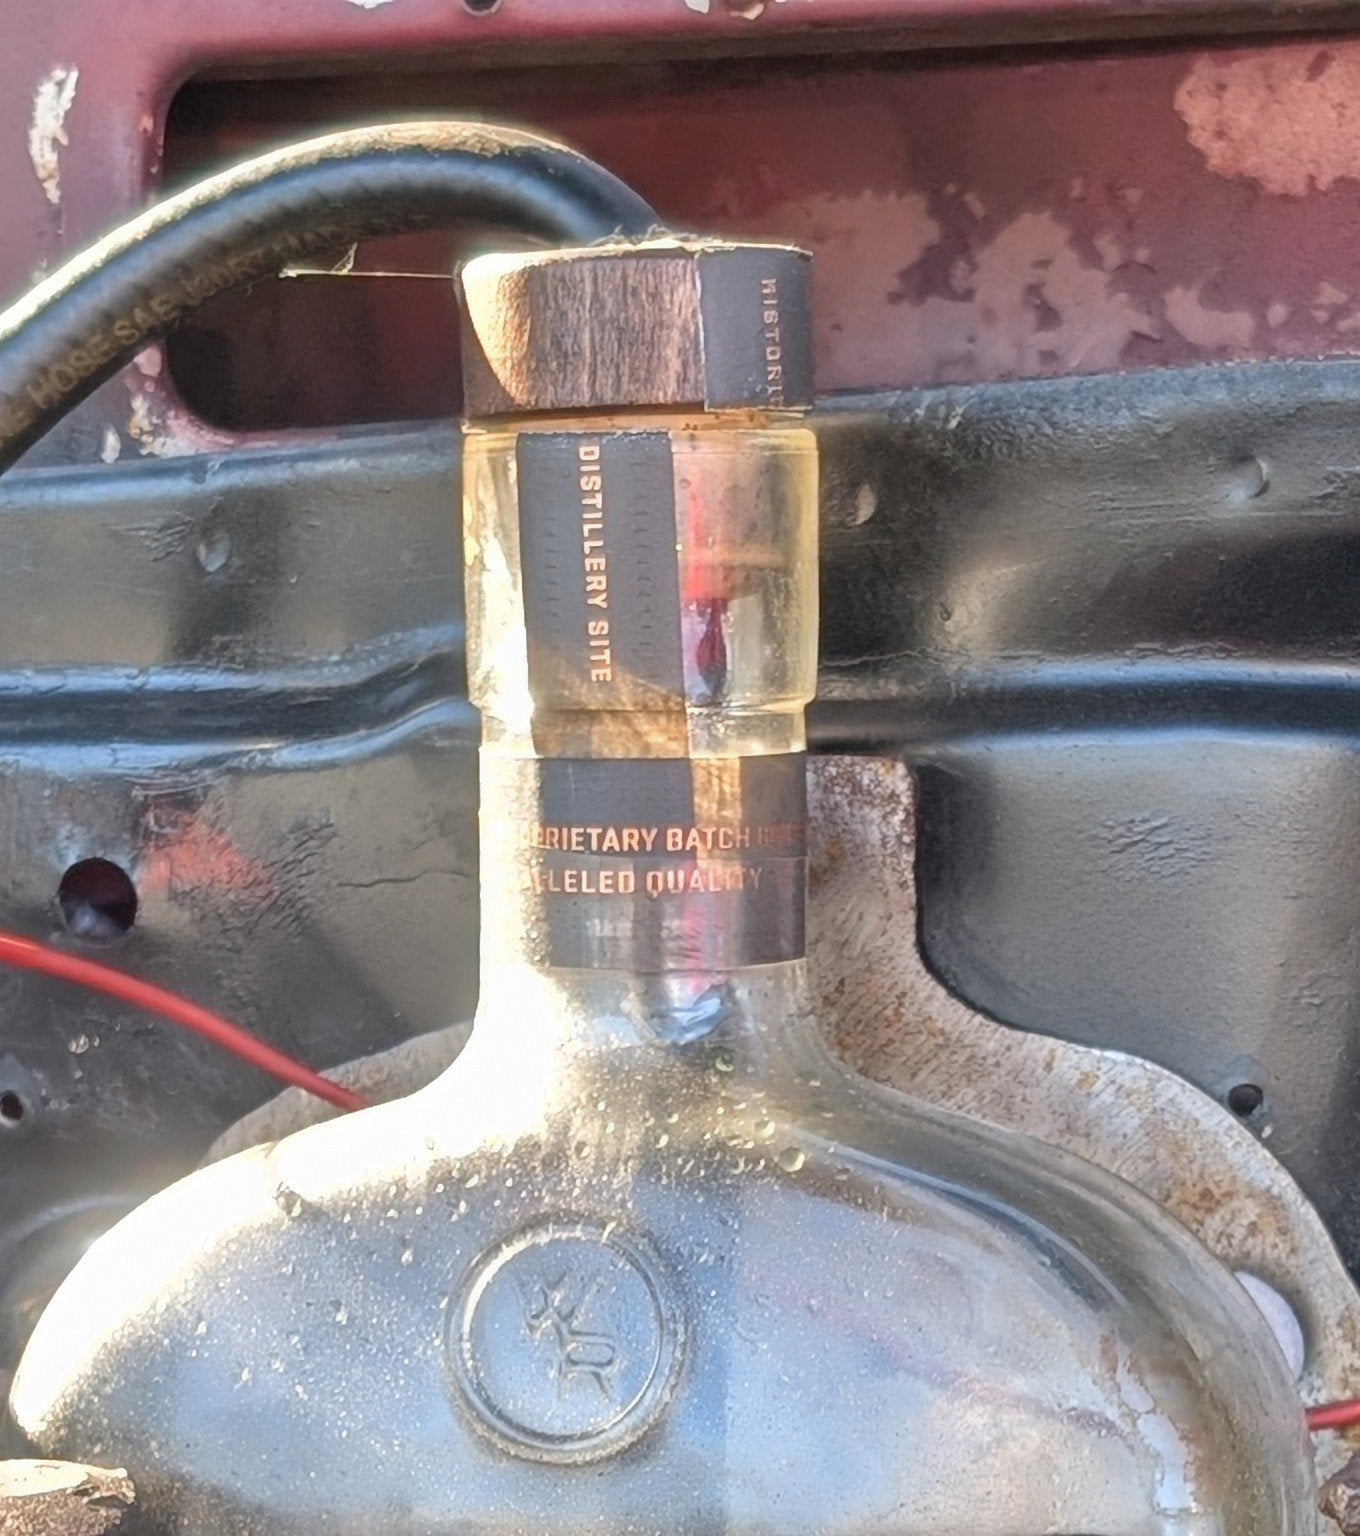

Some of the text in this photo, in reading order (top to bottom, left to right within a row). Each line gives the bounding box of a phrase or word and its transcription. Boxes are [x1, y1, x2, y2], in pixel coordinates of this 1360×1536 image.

[24, 333, 119, 411] HOSE
[112, 289, 181, 345] SAE
[578, 445, 613, 682] DISTILLERY SITE
[517, 824, 658, 852] PRIETARY
[666, 826, 750, 851] BATCH
[646, 866, 763, 900] QUALITY
